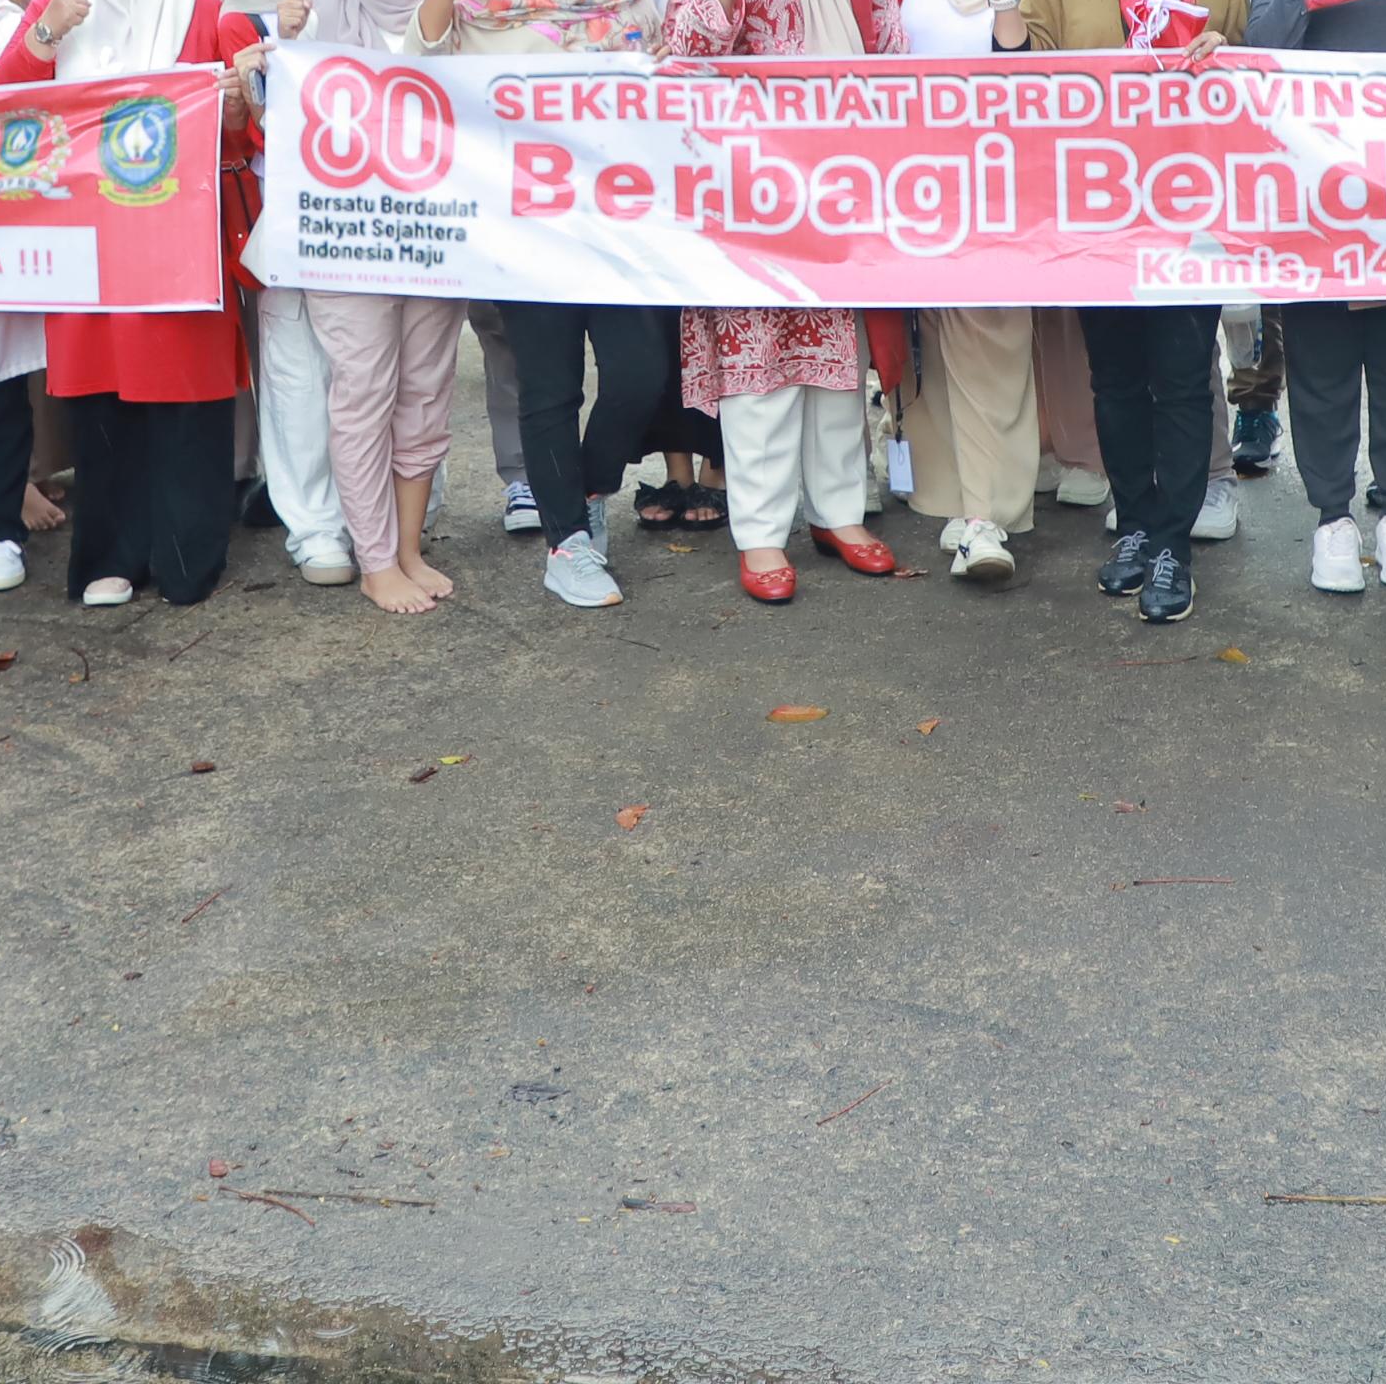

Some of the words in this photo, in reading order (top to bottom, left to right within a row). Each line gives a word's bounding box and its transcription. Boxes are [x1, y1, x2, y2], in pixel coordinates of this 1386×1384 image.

[494, 76, 911, 127] SEKRETARIAT
[930, 78, 1102, 127] DPRD
[299, 56, 455, 192] 80
[299, 192, 375, 213] Bersatu
[381, 196, 479, 217] Berdaulat
[512, 132, 1017, 256] Berbagi
[300, 216, 369, 239] Rakyat
[372, 219, 467, 242] Sejahtera
[19, 249, 54, 277] !!!
[299, 240, 393, 261] Indonesia
[400, 245, 444, 268] Maju
[1139, 247, 1321, 290] Kamis,
